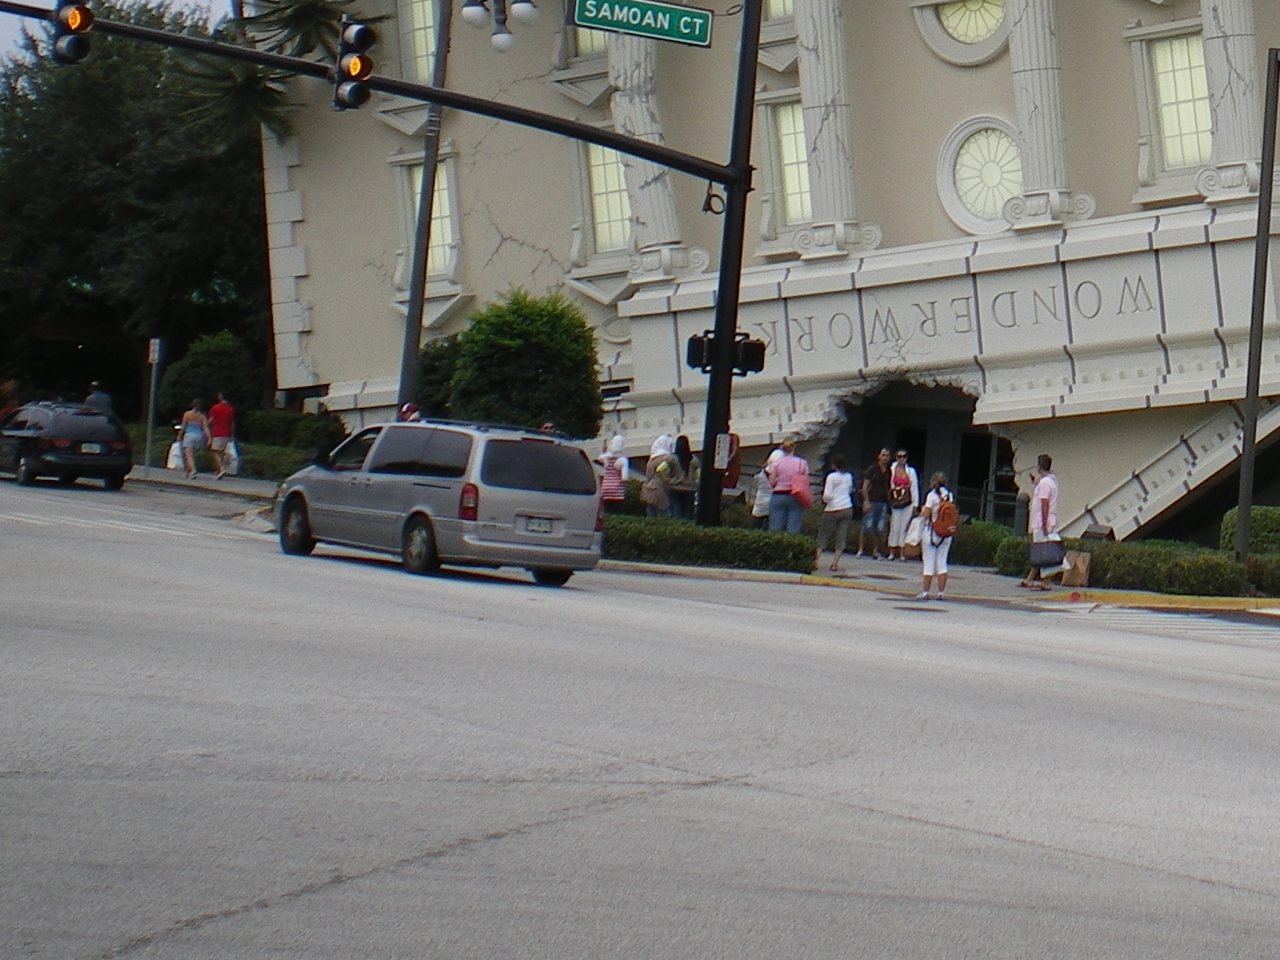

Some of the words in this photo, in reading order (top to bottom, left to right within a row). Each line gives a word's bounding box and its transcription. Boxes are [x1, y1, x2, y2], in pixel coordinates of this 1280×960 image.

[584, 0, 670, 31] SAMOAN
[679, 16, 704, 36] CT
[740, 274, 1158, 356] WONDERWORK
